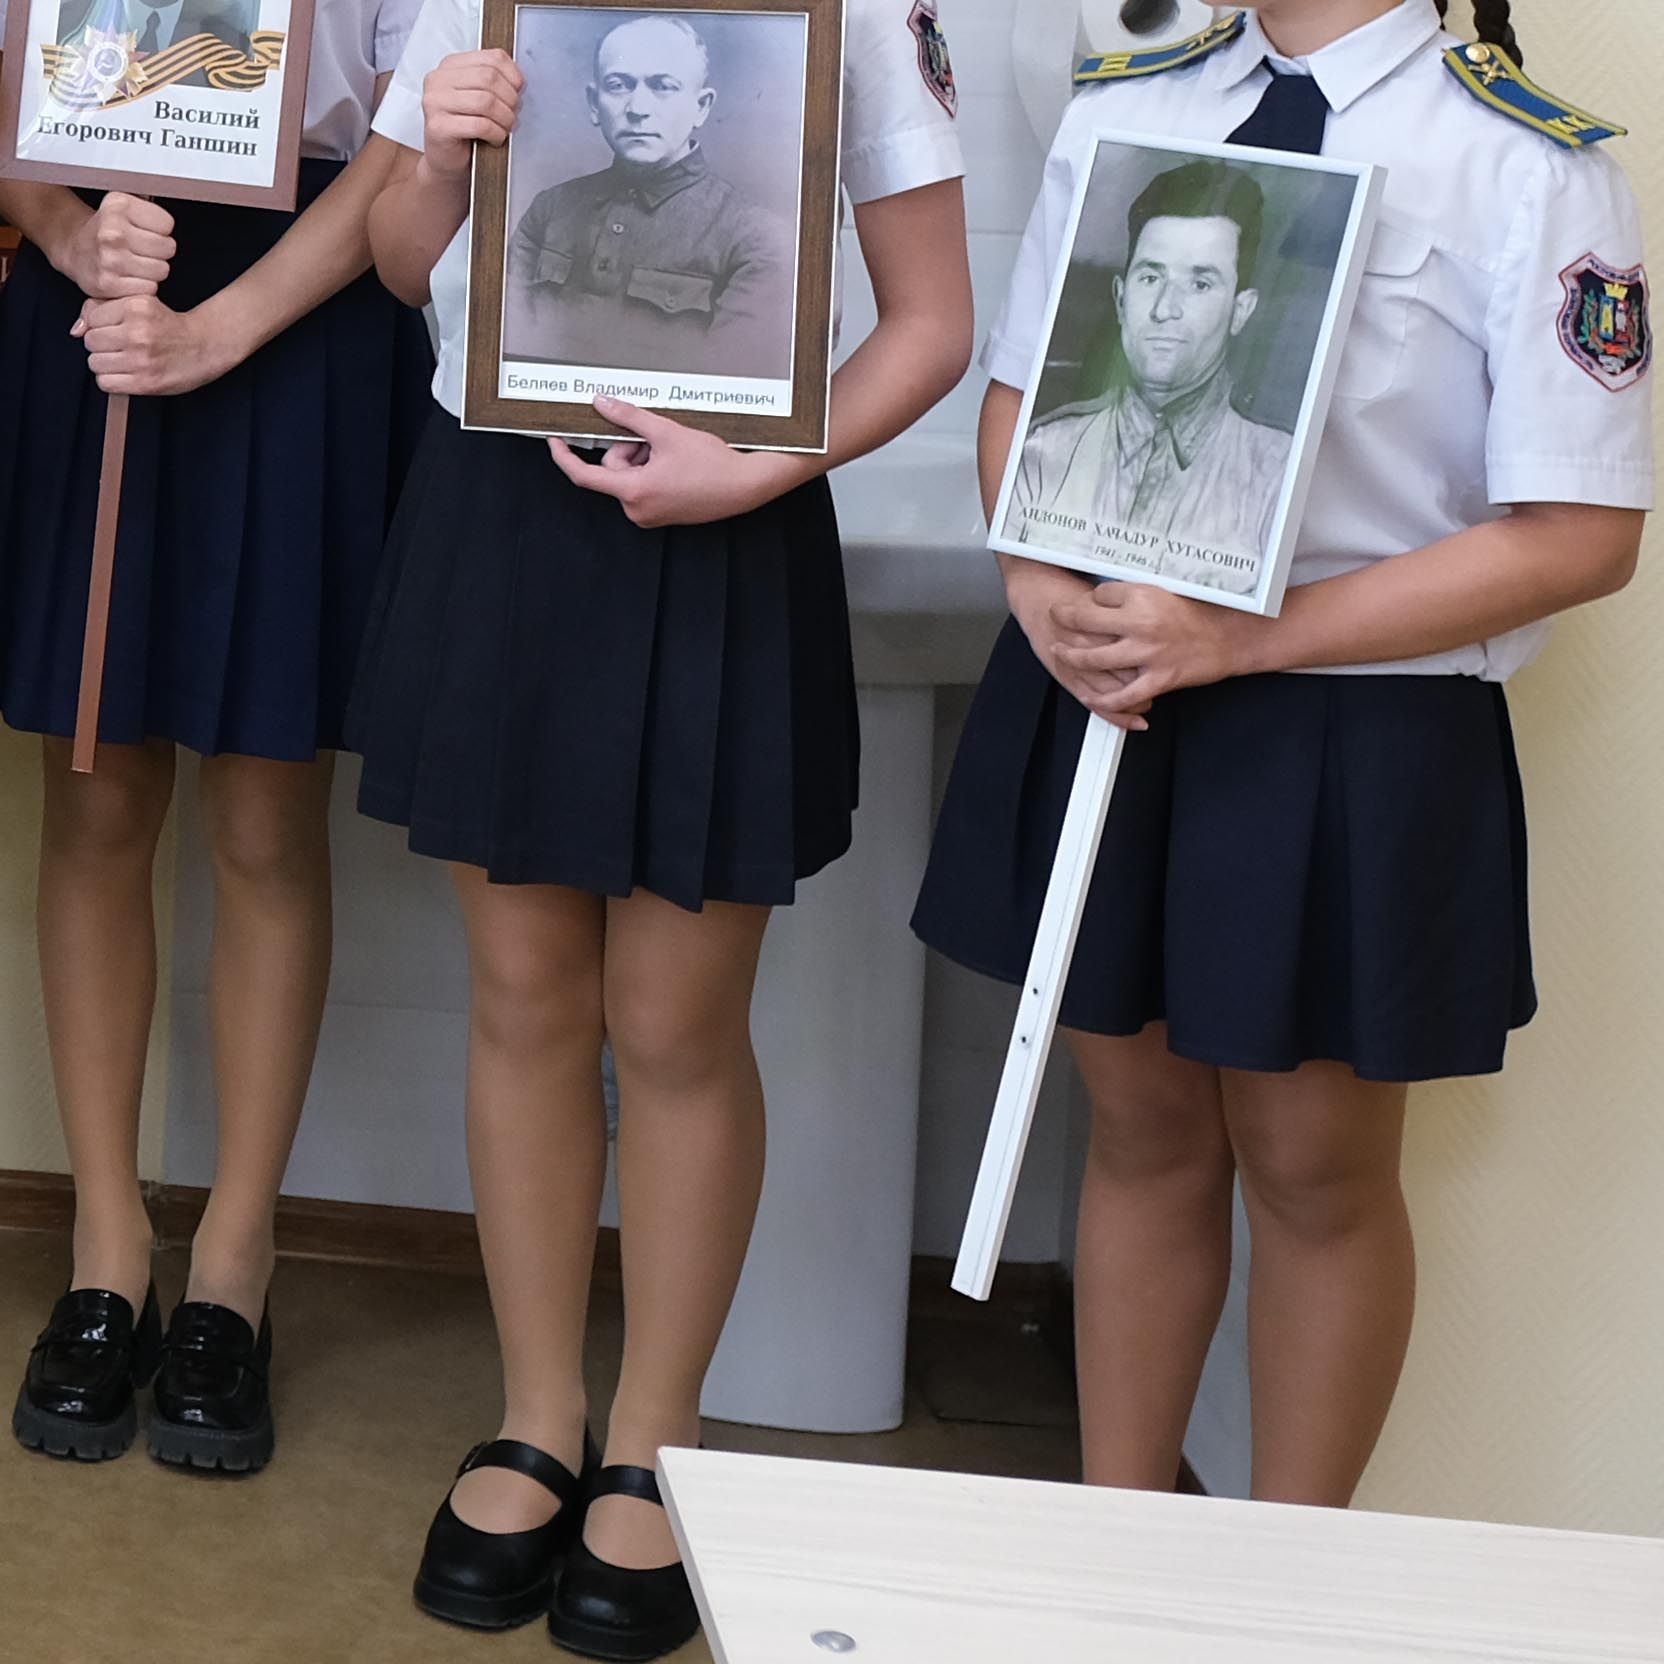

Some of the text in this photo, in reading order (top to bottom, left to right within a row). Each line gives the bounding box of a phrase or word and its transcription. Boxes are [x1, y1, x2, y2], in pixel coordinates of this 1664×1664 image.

[154, 99, 261, 131] Василий
[38, 115, 258, 157] Егорович Ганшин
[507, 374, 776, 407] Беляев Владимир Дмитриевич
